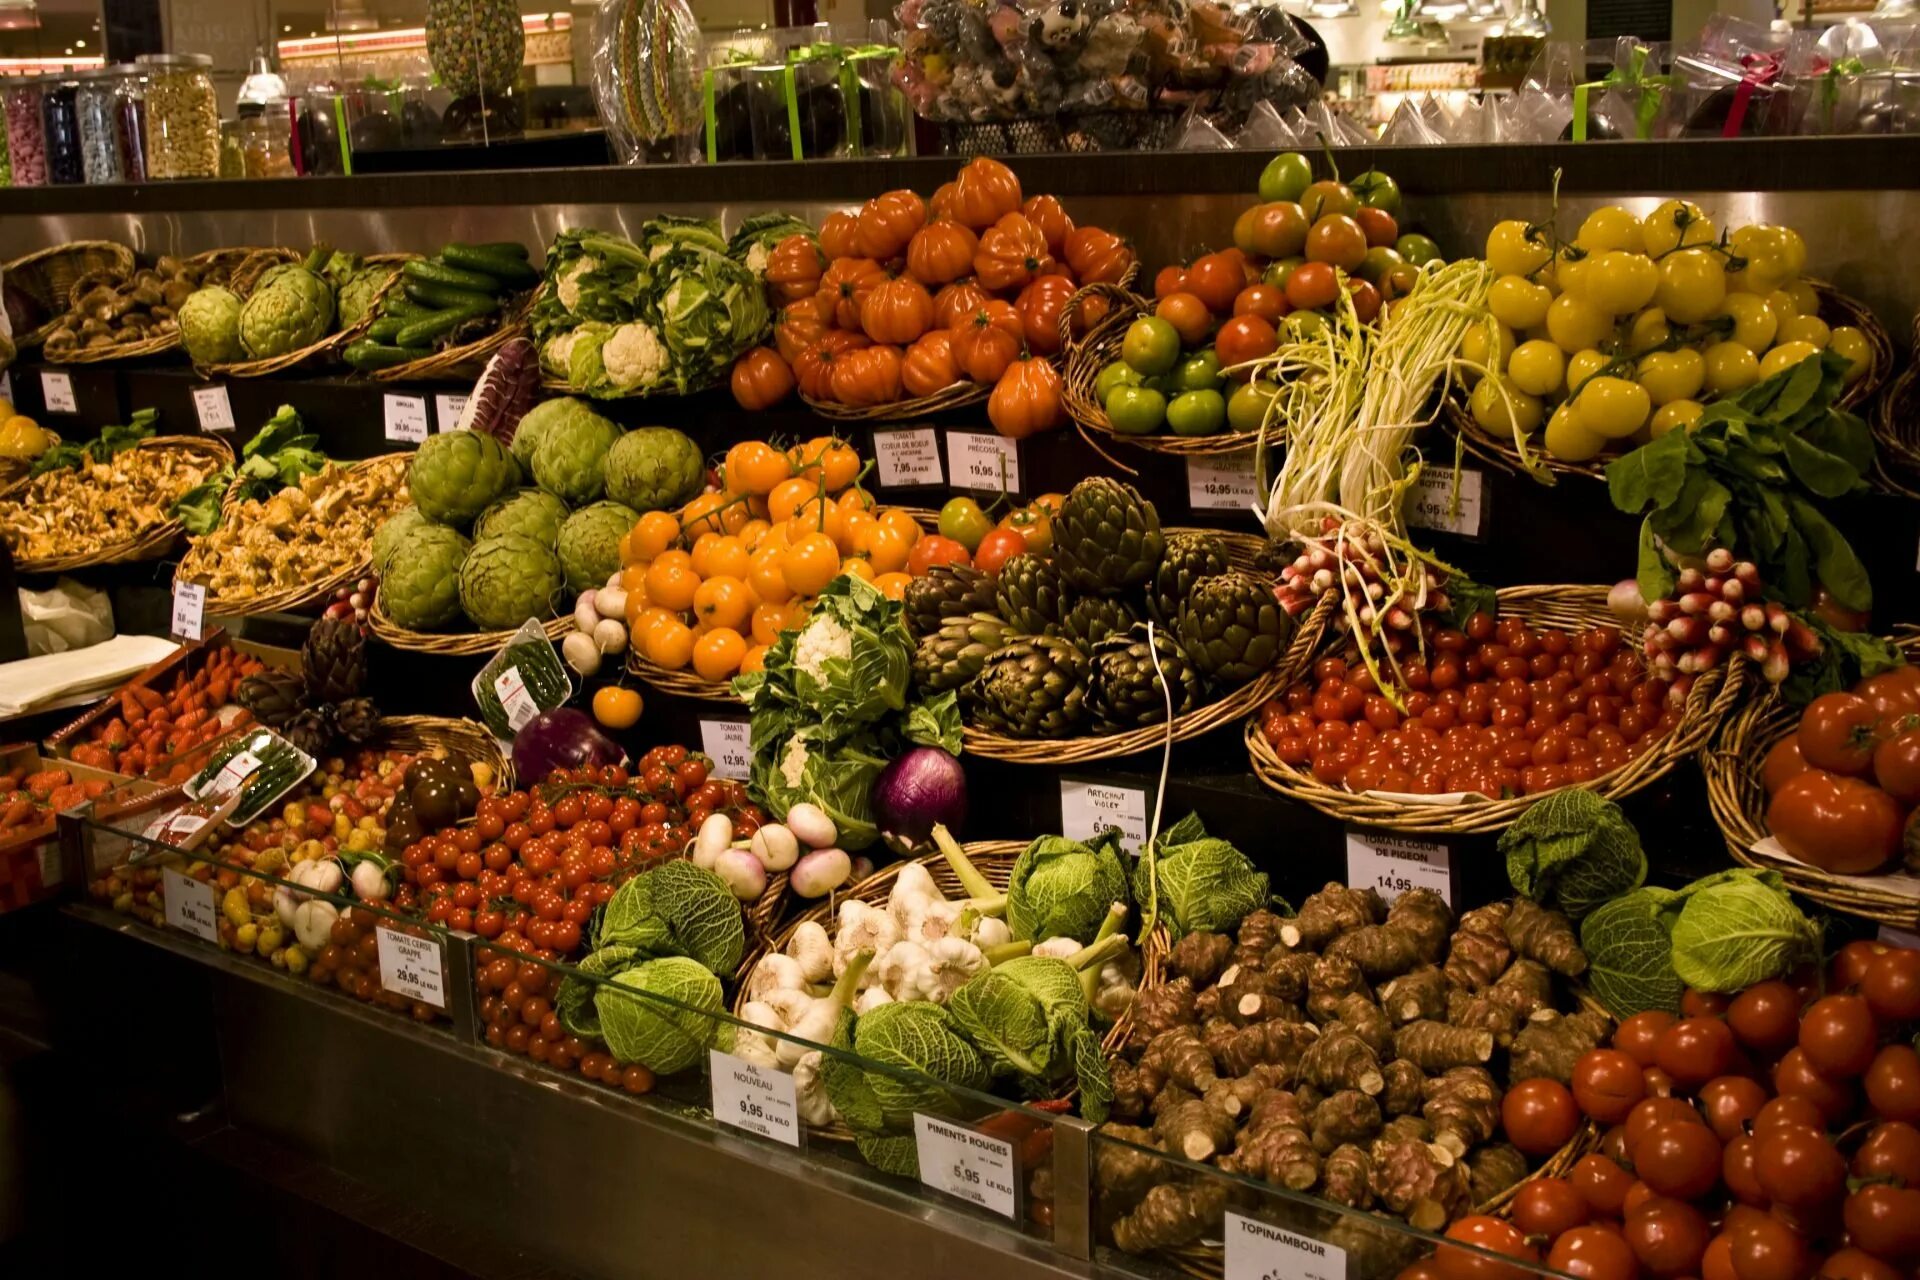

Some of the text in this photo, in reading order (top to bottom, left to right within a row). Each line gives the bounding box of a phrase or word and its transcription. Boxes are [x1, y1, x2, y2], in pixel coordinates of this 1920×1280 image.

[892, 432, 915, 440] TOMATE
[971, 436, 995, 445] TREVISE
[882, 441, 900, 449] COEUR
[911, 440, 929, 448] BOEUF
[894, 463, 910, 474] 7,95
[970, 466, 993, 476] 19,95
[1205, 484, 1230, 496] 12,95
[1416, 501, 1440, 515] 4,95
[720, 723, 744, 732] TOMATE
[725, 734, 743, 742] JAUNE
[723, 755, 745, 767] 12,95
[1127, 832, 1140, 840] KILO
[1365, 834, 1439, 852] TOMATE COEUR
[1376, 848, 1428, 862] DE PIGEON
[1378, 876, 1411, 891] 14,95
[386, 932, 432, 952] TOMATE CERISE
[398, 946, 421, 960] GRAPPE
[397, 969, 419, 984] 29,95
[734, 1071, 773, 1091] NOUVEAU
[740, 1101, 762, 1118] 9,95
[766, 1113, 773, 1122] LE
[775, 1117, 790, 1127] KILO
[928, 1122, 1008, 1156] PIMENTS ROUGES
[954, 1165, 1012, 1195] 5,95 LE KILO
[1240, 1221, 1325, 1256] TOPINAMBOUR
